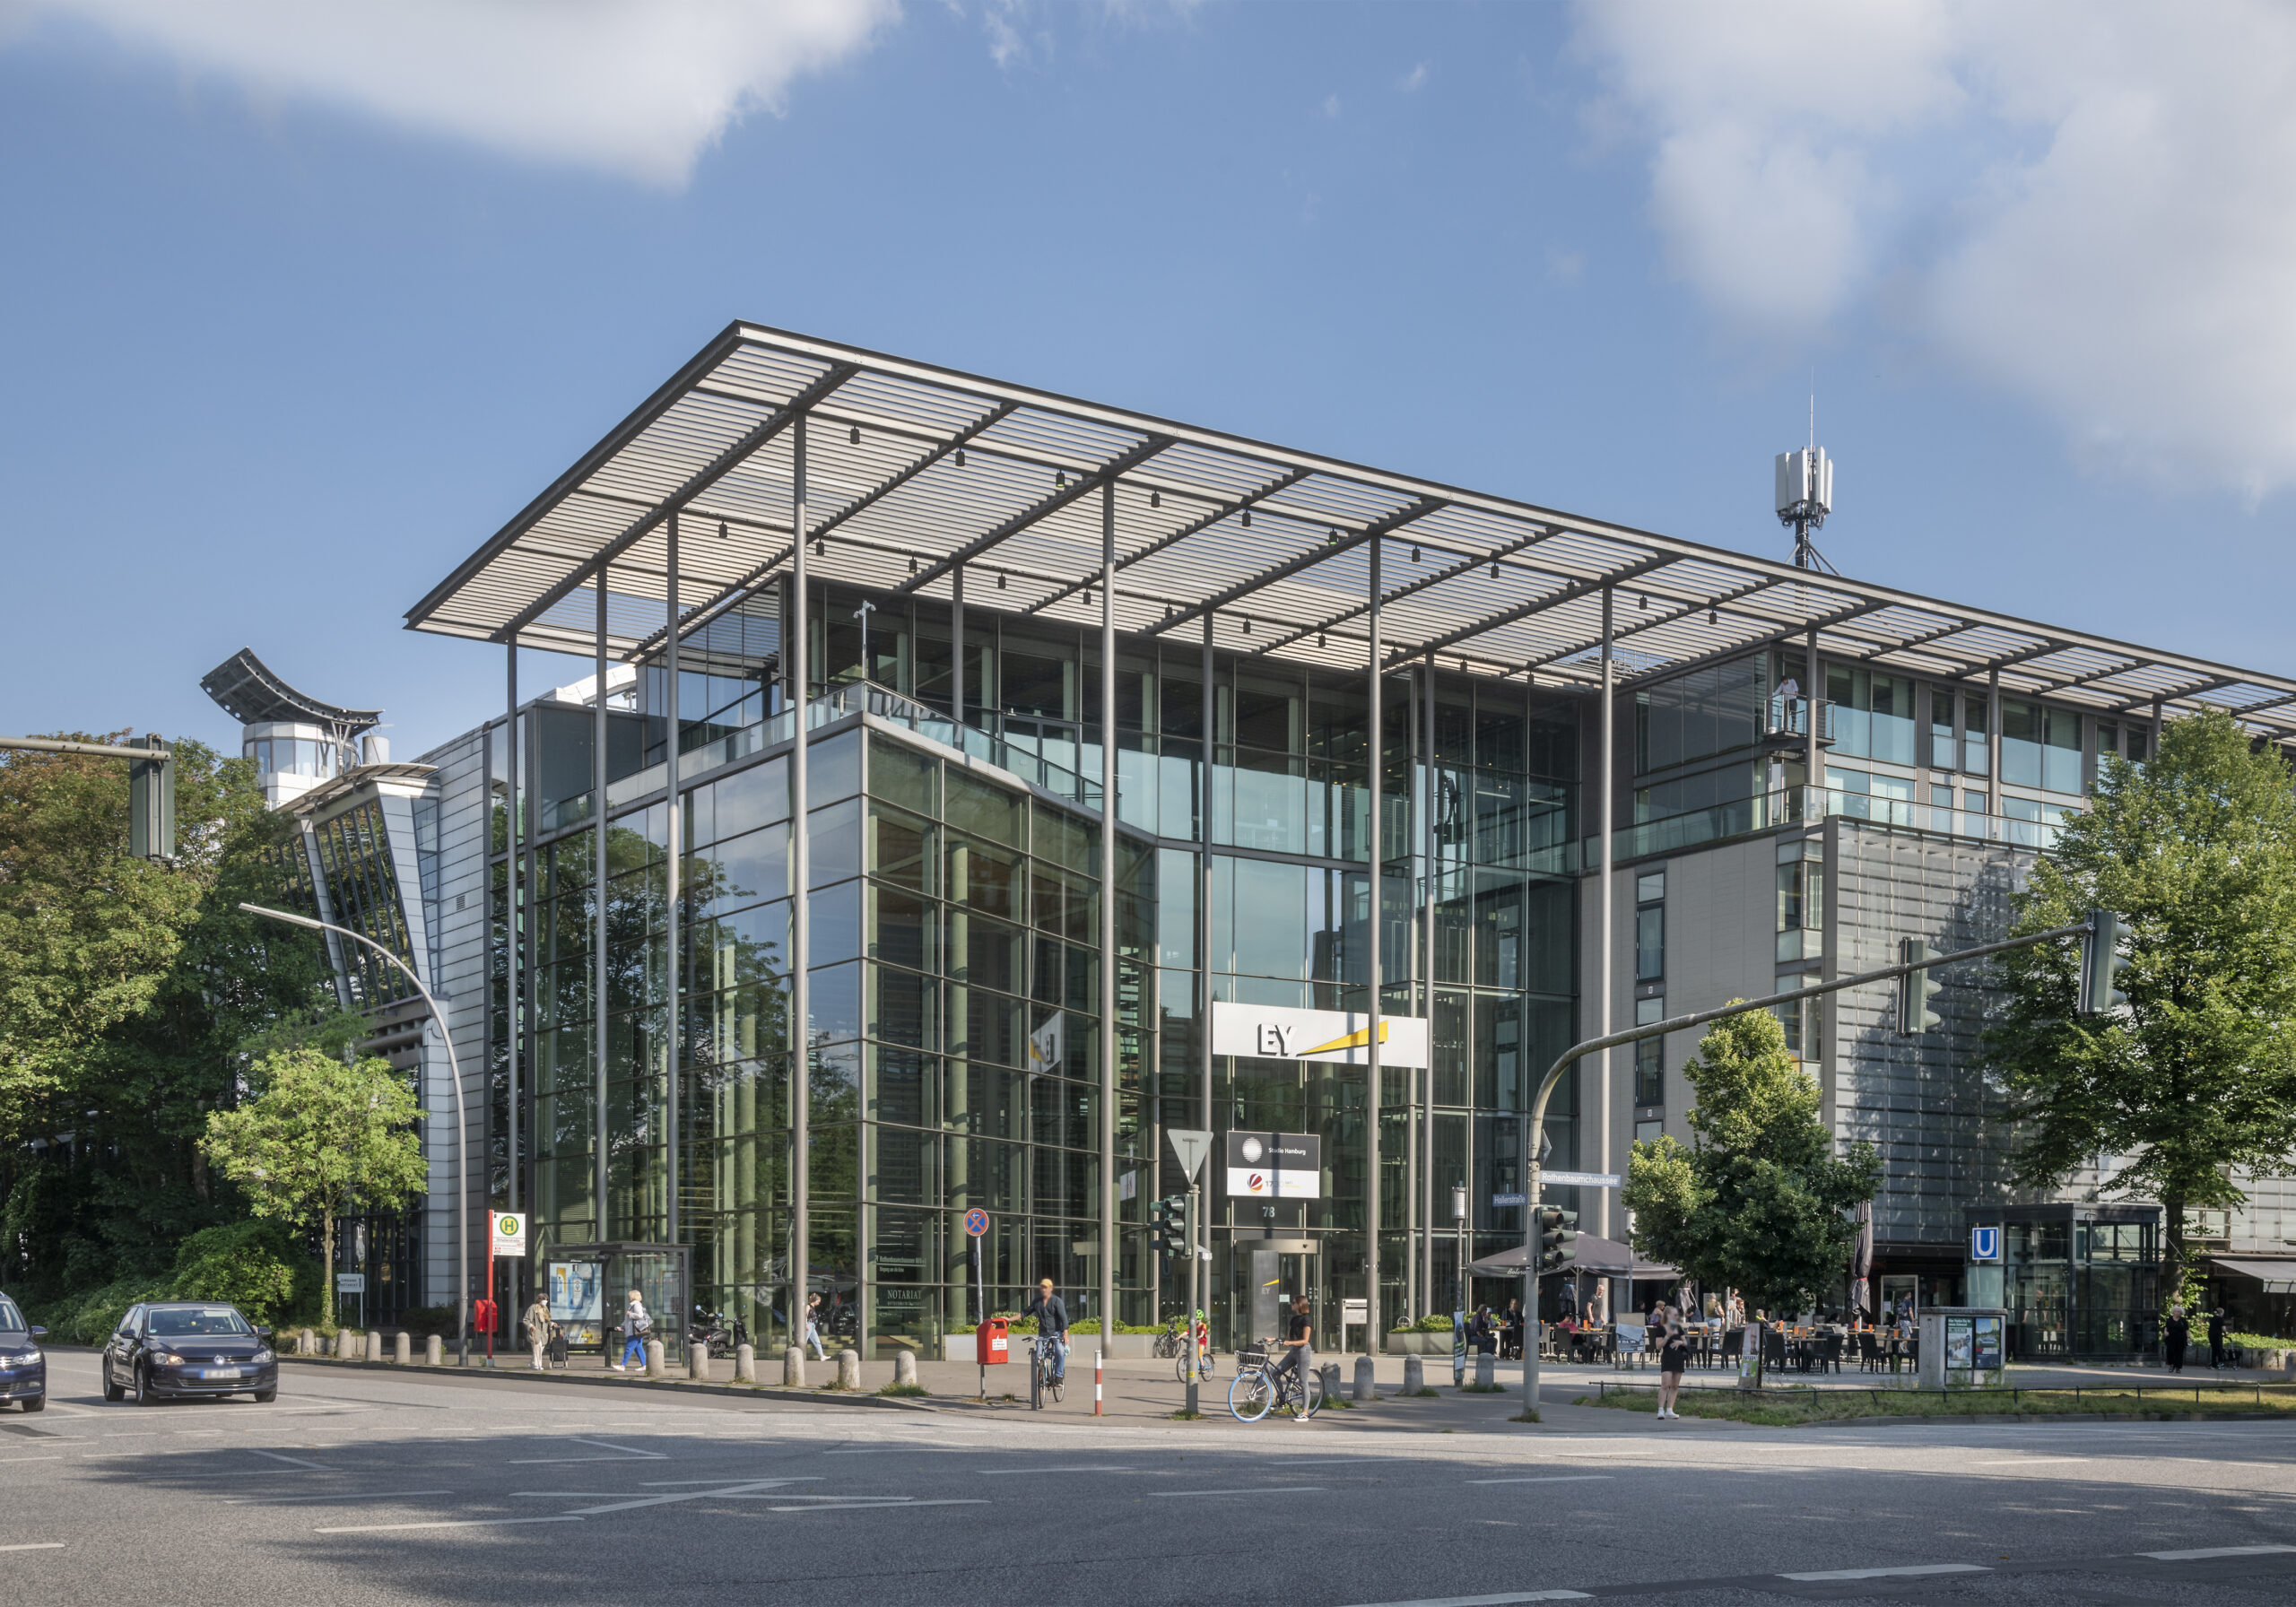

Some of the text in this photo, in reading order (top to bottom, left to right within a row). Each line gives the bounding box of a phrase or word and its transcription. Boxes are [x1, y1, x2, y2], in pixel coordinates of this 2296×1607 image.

[1257, 1023, 1298, 1056] EY
[1284, 1148, 1306, 1156] Hamburg
[1542, 1172, 1618, 1185] Rothenbaumchaussee
[1494, 1194, 1526, 1204] Hallerstraße
[1262, 1206, 1275, 1218] 78
[504, 1220, 514, 1231] H
[1976, 1229, 1995, 1256] U
[887, 1290, 922, 1299] NOTARIAT
